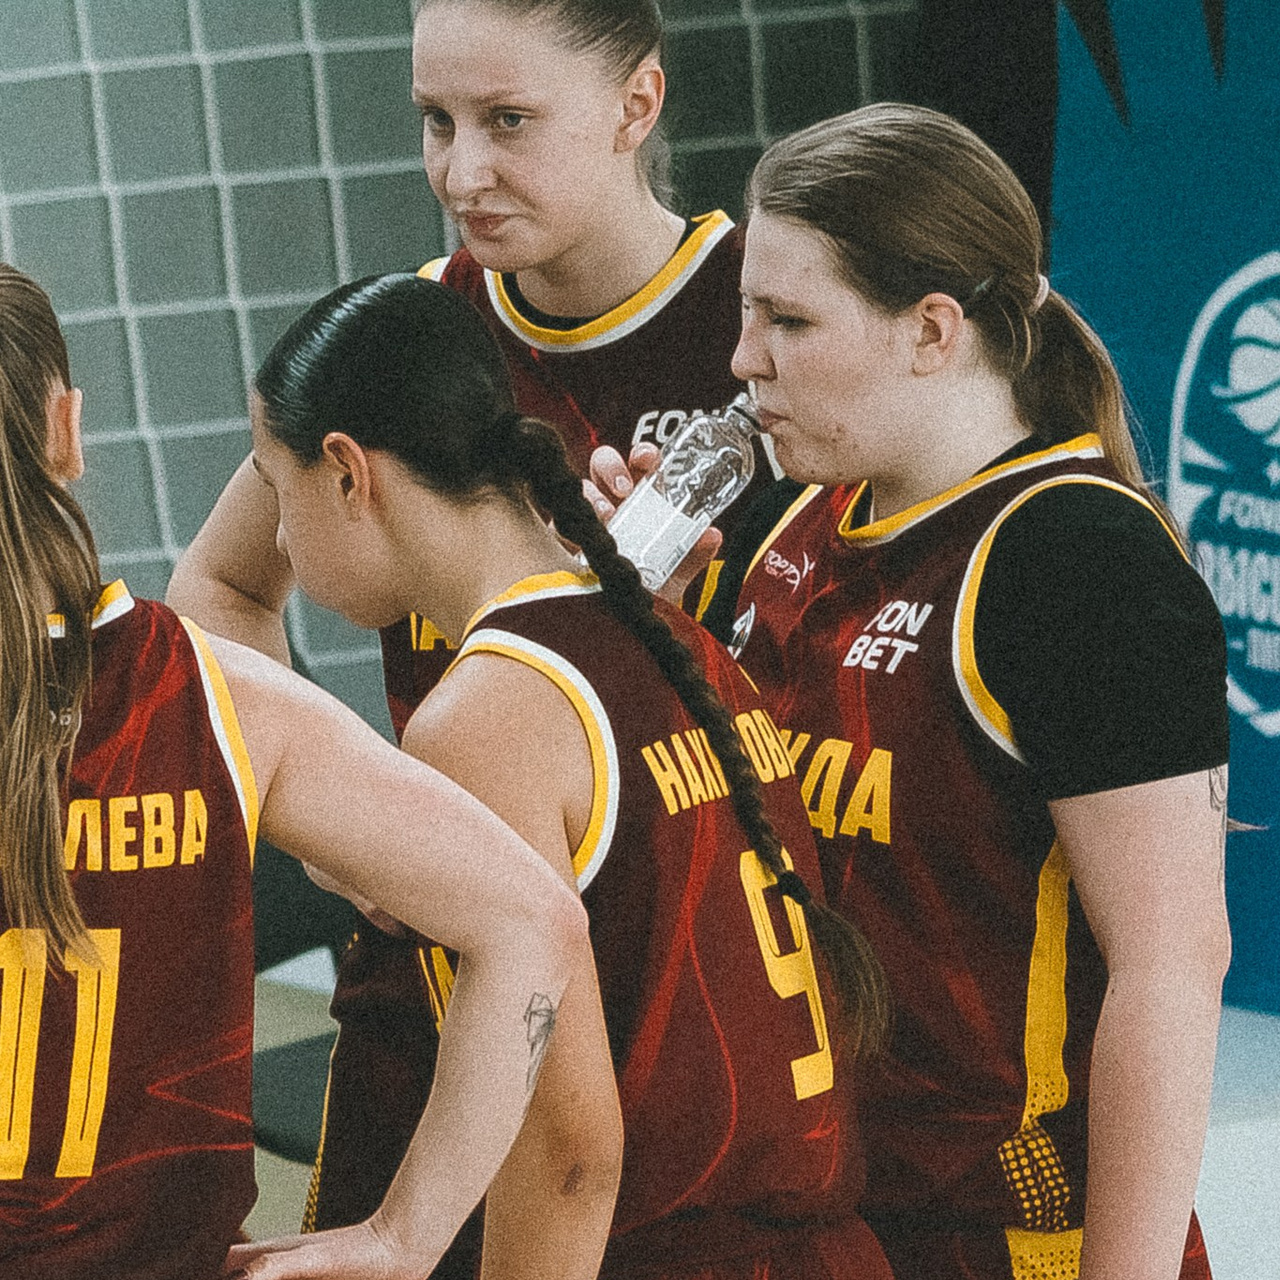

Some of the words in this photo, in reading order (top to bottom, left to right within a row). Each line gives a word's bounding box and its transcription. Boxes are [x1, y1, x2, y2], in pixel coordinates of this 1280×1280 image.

[632, 410, 720, 446] FO
[842, 634, 919, 674] BET
[739, 845, 834, 1100] 9
